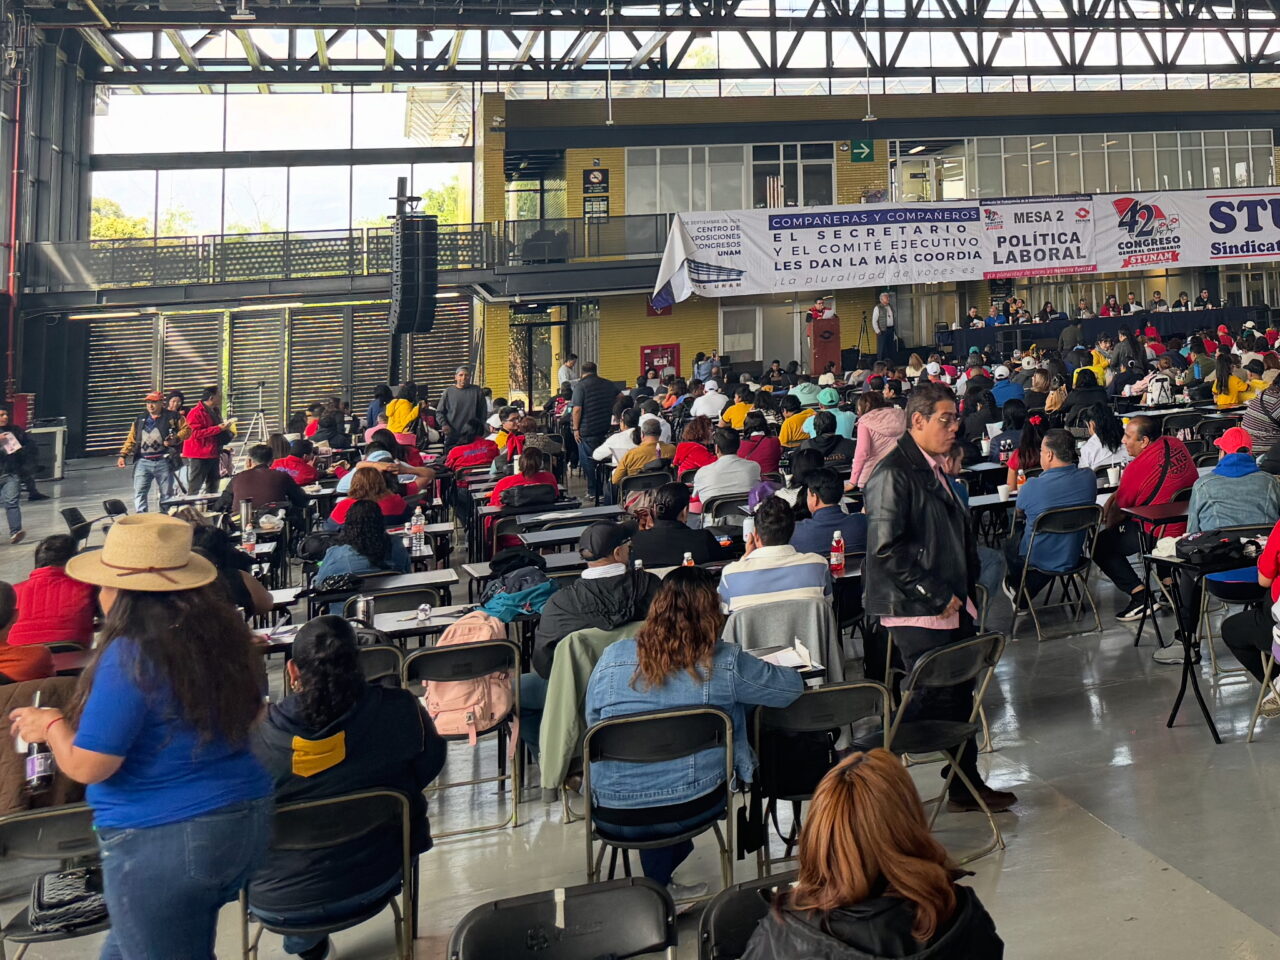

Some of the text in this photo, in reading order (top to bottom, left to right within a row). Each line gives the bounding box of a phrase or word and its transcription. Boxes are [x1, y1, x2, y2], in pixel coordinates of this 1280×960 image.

[772, 210, 977, 227] COMPAÑERAS Y COMPAÑEROS
[1014, 211, 1052, 224] MESA
[1056, 210, 1064, 221] 2
[691, 233, 741, 241] XPOSICIONES
[696, 225, 729, 233] CENTRO
[773, 225, 966, 242] EL SECRETARIO
[774, 237, 979, 256] Y EL COMITÉ EJECUTIVO
[997, 231, 1081, 248] POLÍTICA
[1118, 236, 1181, 250] CONGRESO
[993, 246, 1086, 265] LABORAL
[1147, 245, 1181, 253] ORDINARIO
[774, 251, 982, 271] LES DAN LA MÁS COORDIA
[1130, 252, 1172, 264] STUNAM
[805, 270, 885, 286] pluralidad
[893, 270, 909, 278] de
[917, 267, 954, 277] voces
